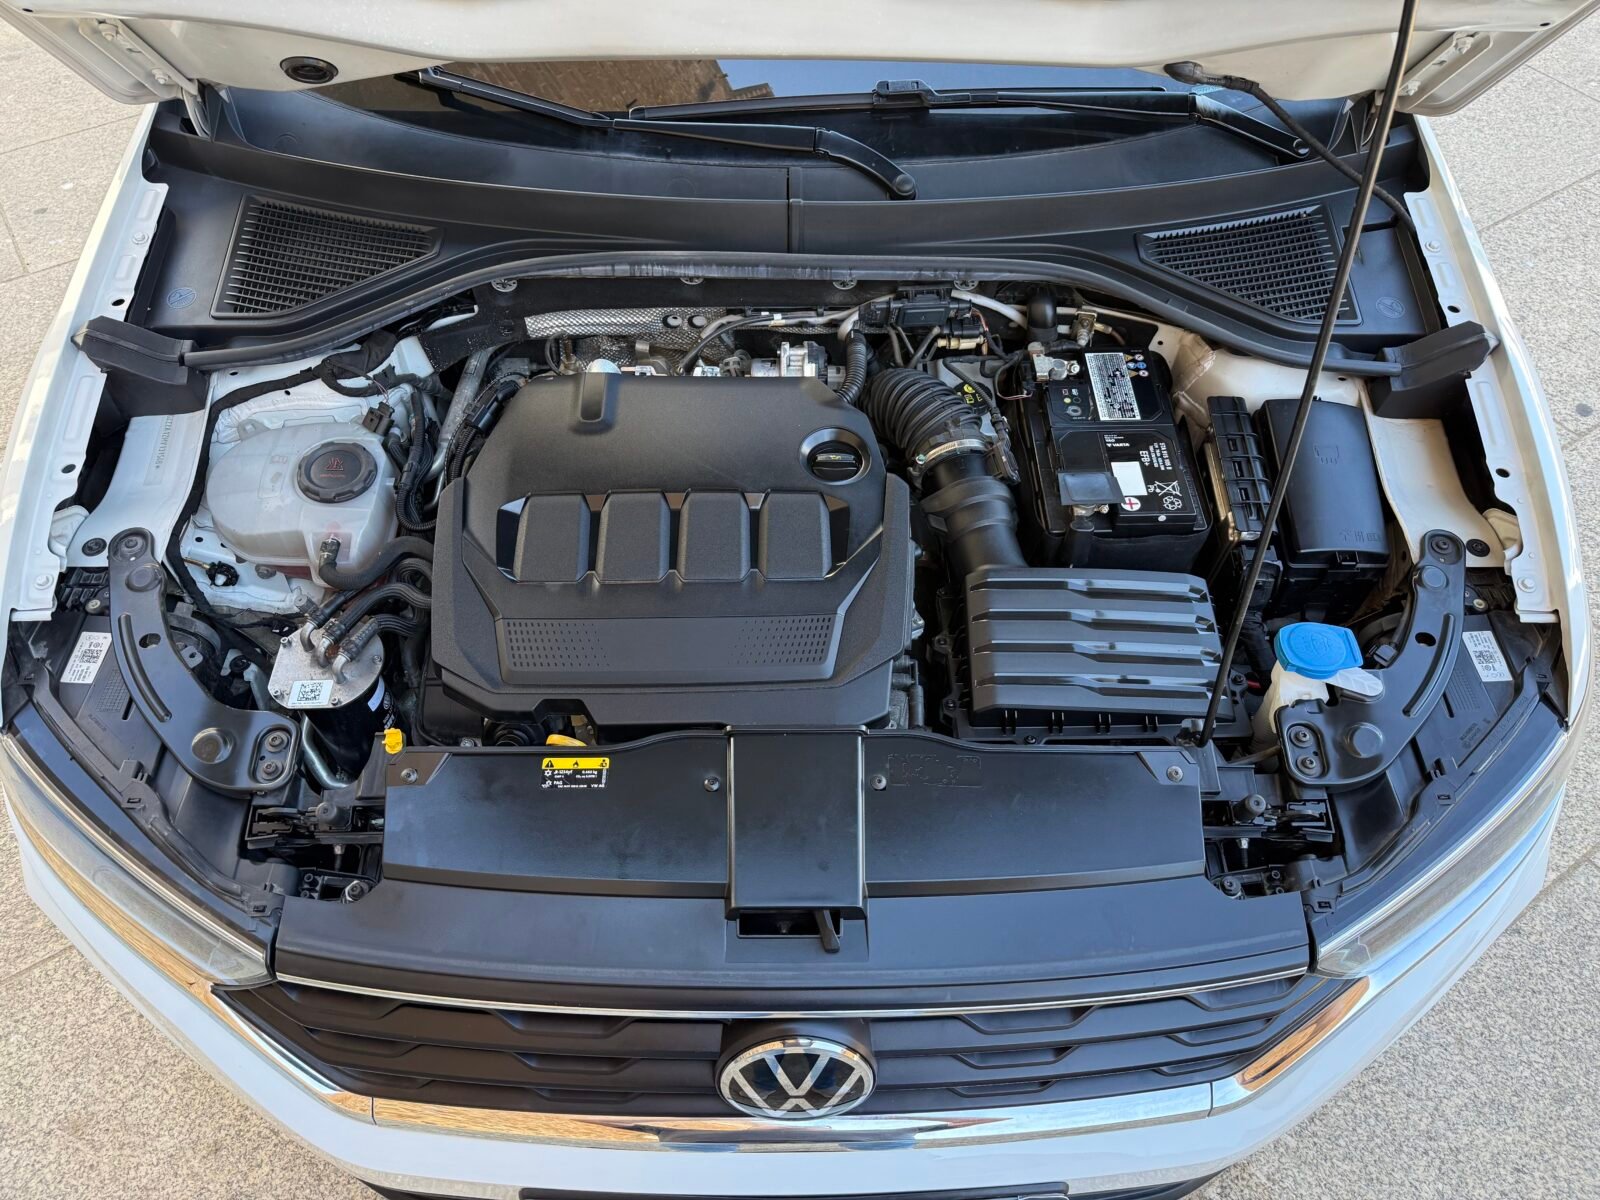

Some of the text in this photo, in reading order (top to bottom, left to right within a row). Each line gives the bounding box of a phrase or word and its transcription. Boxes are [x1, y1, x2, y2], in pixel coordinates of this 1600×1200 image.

[1139, 450, 1150, 466] EFB+
[1147, 484, 1155, 493] Pb
[722, 1044, 870, 1117] VW
